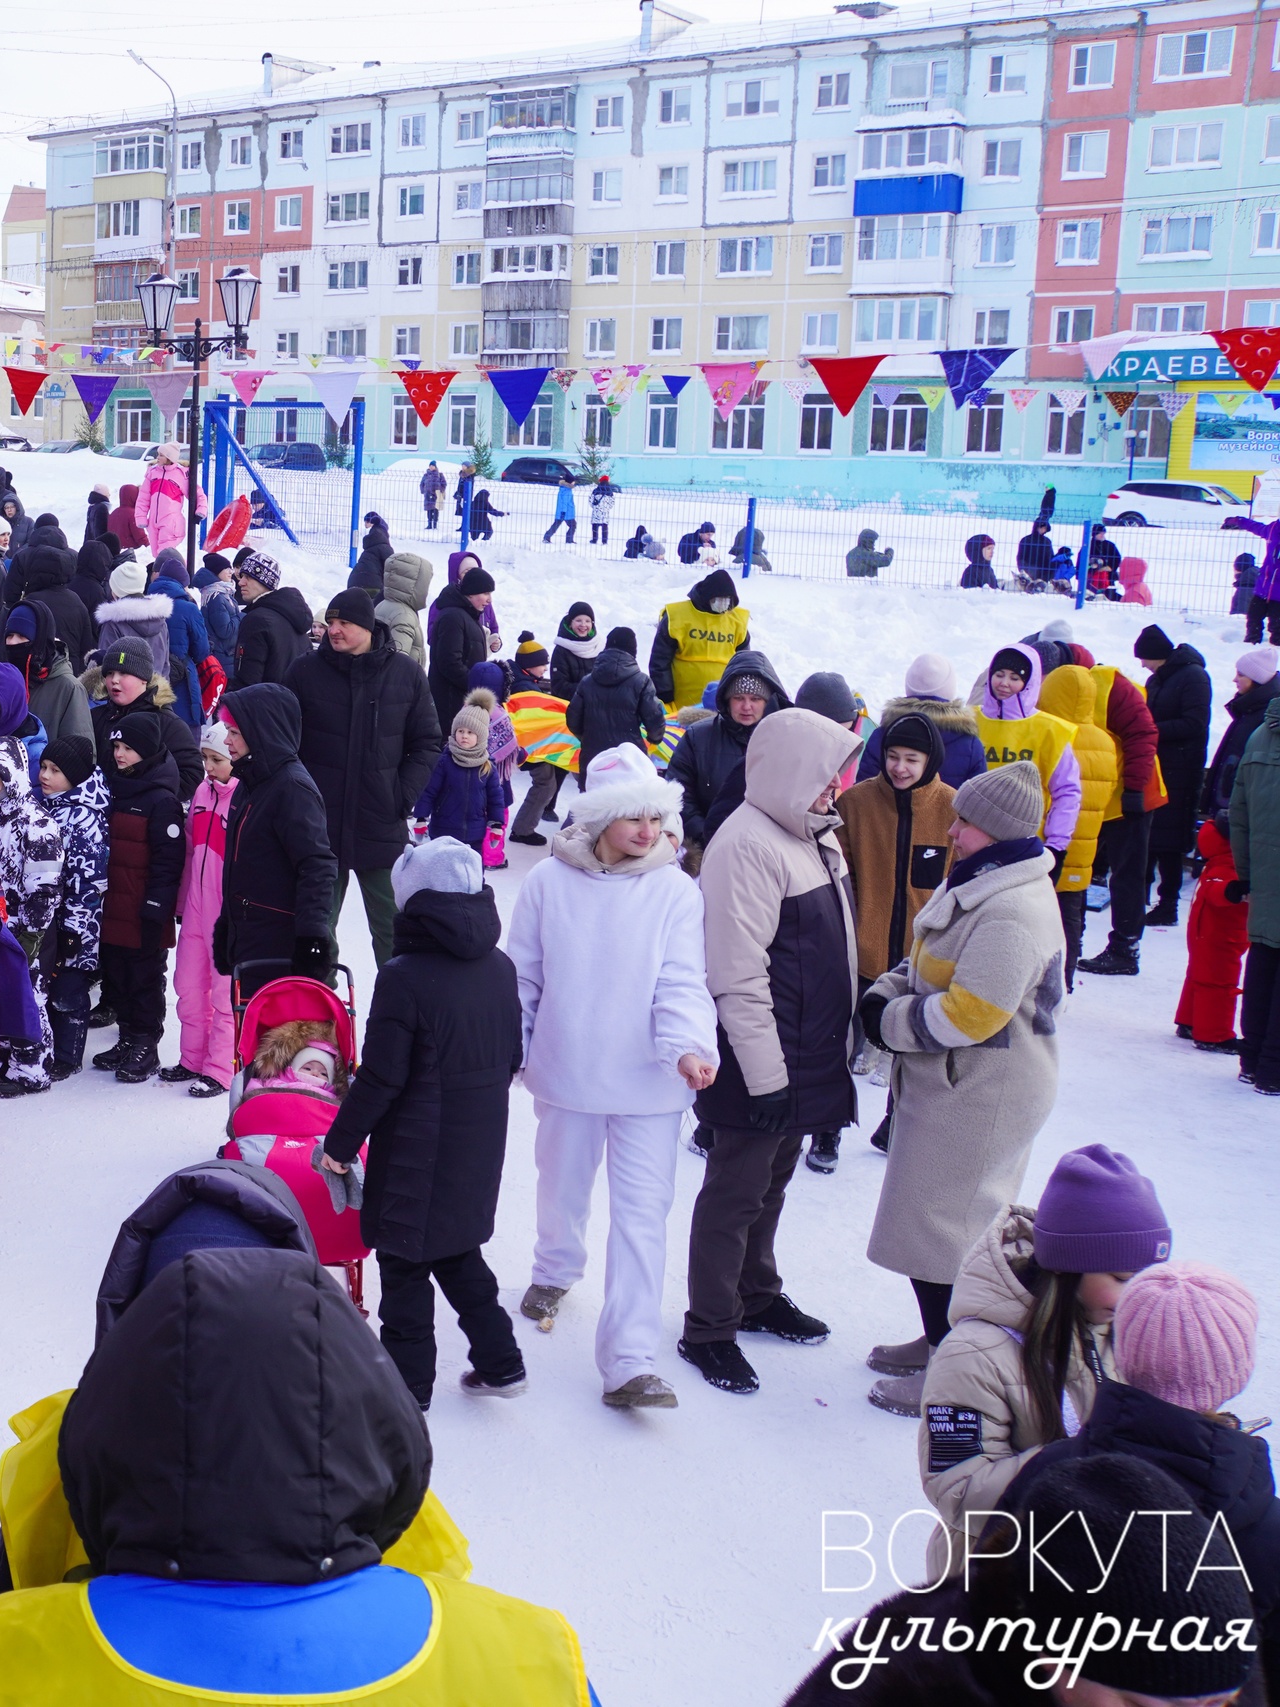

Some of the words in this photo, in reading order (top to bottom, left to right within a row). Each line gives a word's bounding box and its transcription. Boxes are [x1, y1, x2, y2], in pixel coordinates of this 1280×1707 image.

[1107, 353, 1240, 379] КРАЕВЕ
[1247, 430, 1280, 442] Ворк
[1218, 441, 1280, 453] музейно-
[688, 628, 735, 644] СУДЬЯ
[984, 746, 1034, 762] ДЬЯ
[928, 1406, 954, 1415] MAKE
[930, 1422, 955, 1433] OWN
